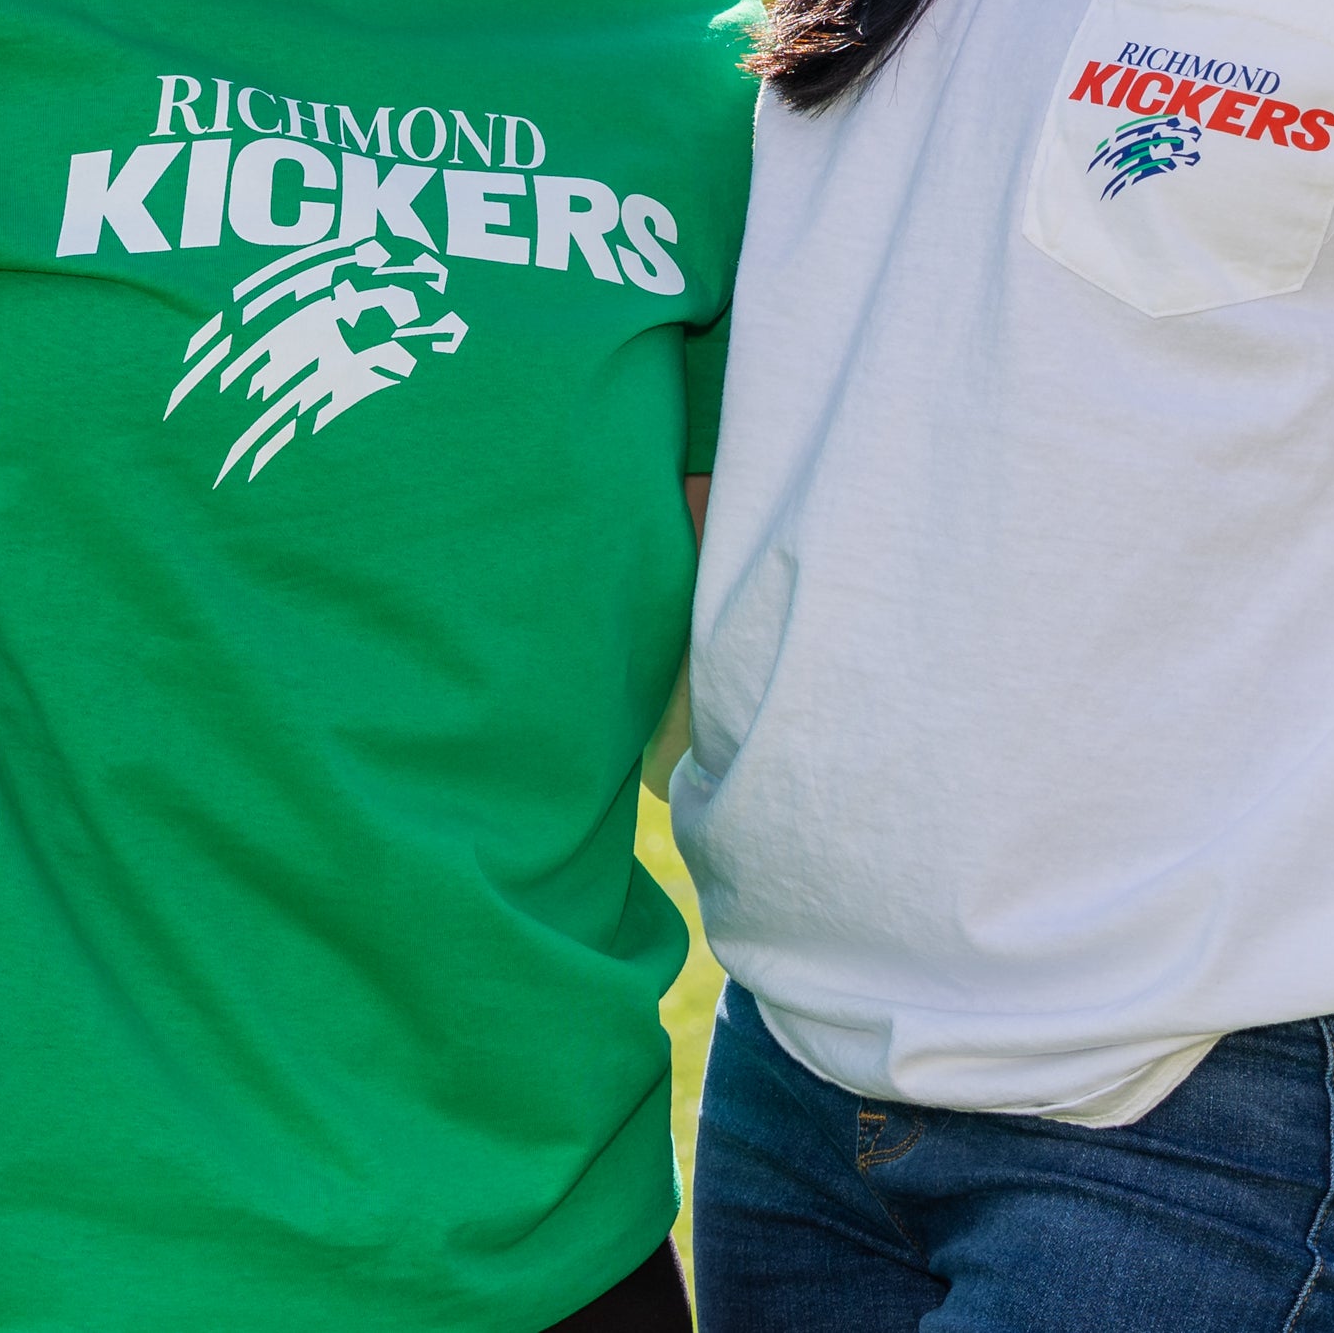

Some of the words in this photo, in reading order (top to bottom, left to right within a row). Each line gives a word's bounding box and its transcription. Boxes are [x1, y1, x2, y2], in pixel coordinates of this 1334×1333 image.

[1117, 41, 1280, 95] RICHMOND
[150, 74, 546, 168] RICHMOND
[57, 138, 686, 295] KICKERS
